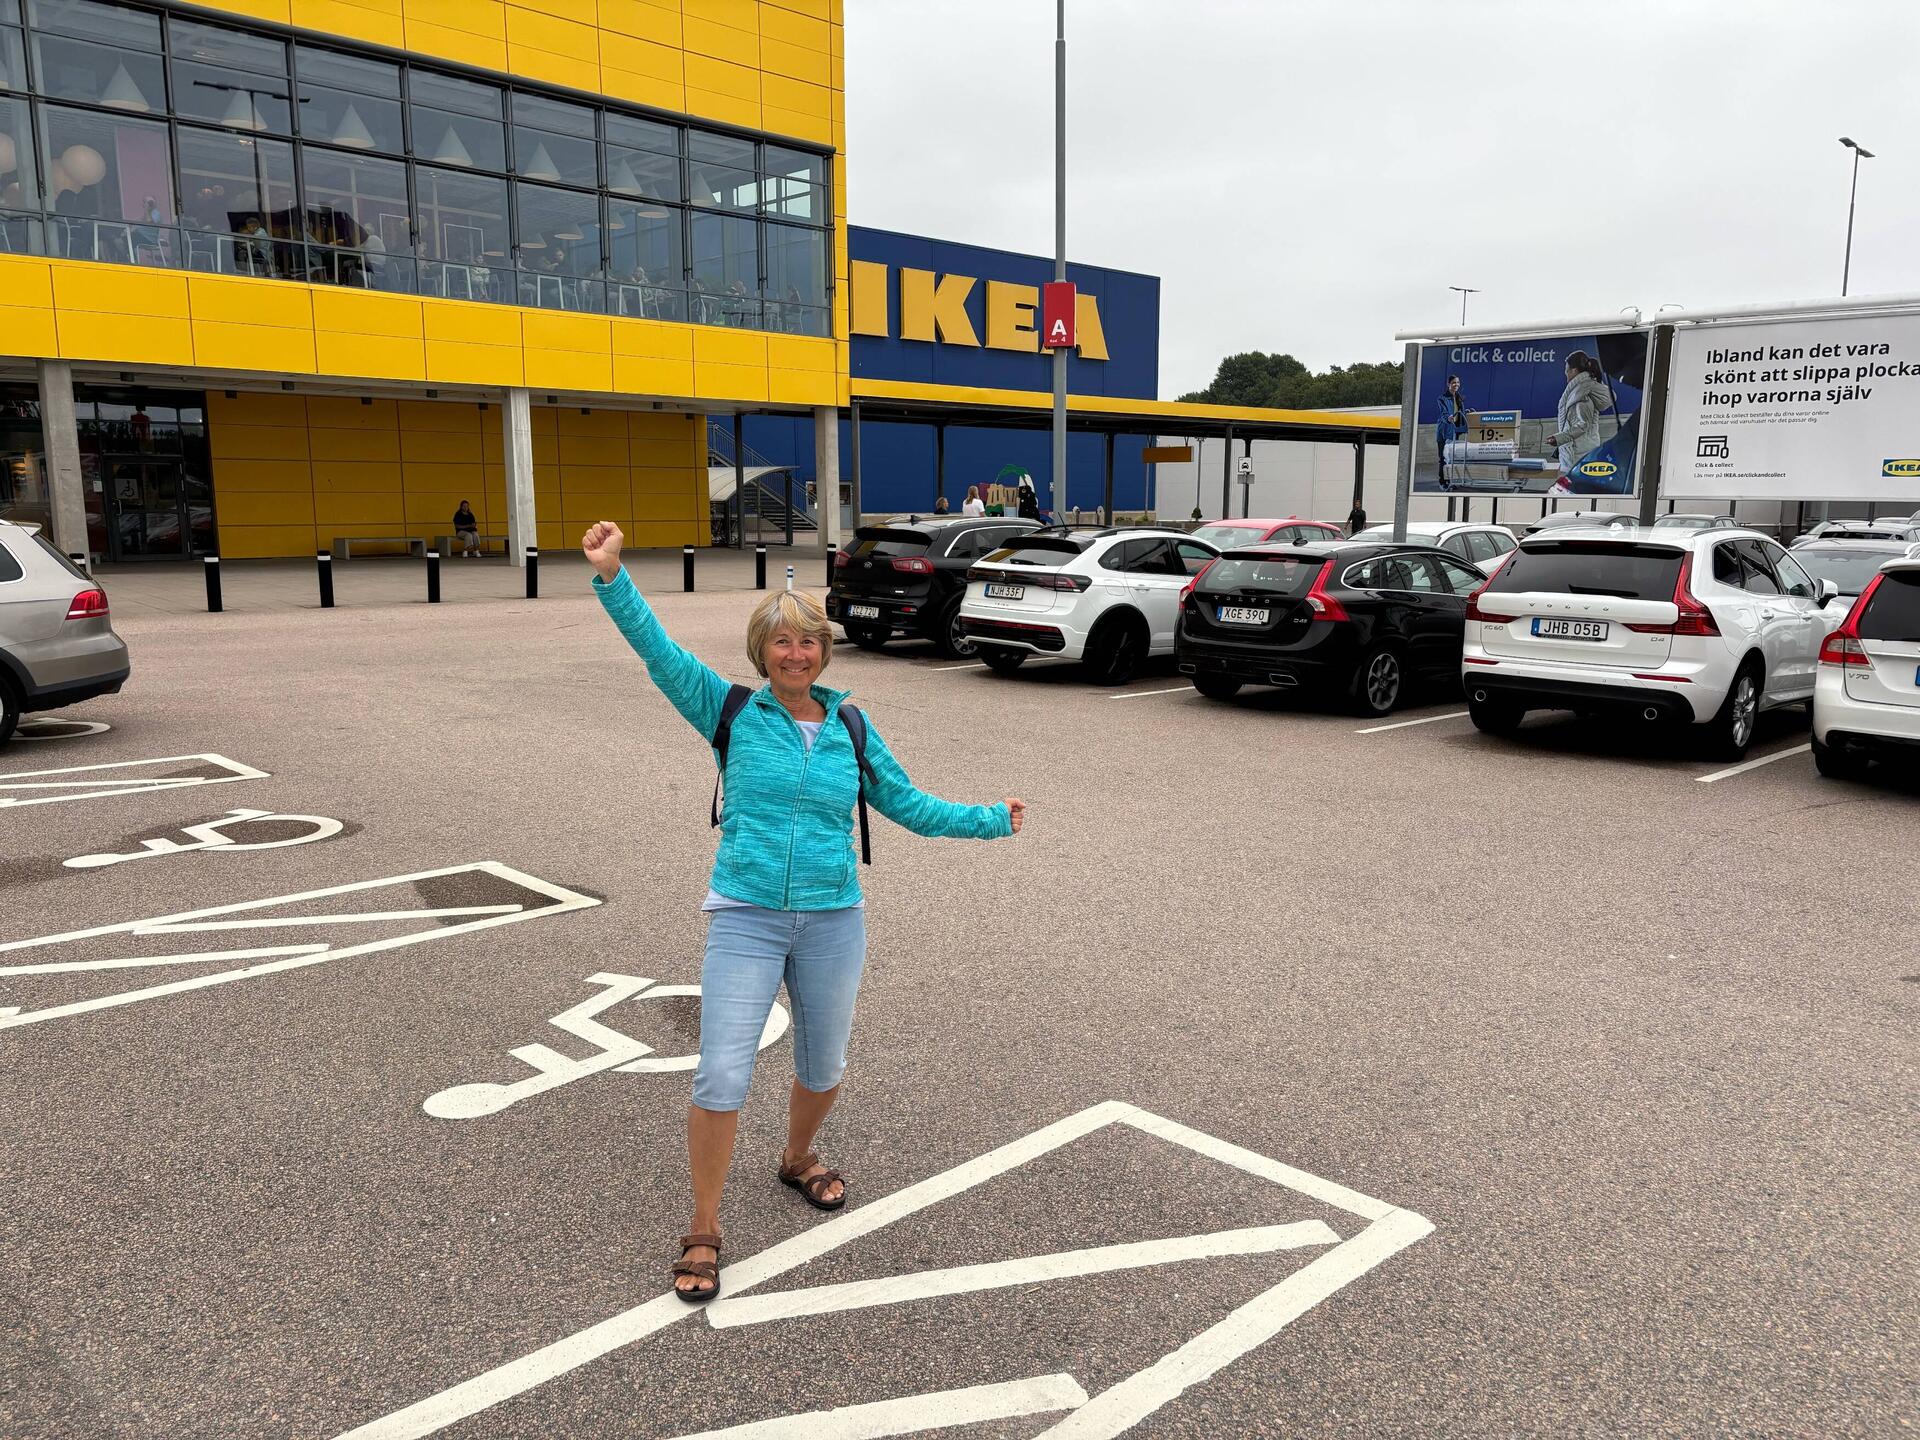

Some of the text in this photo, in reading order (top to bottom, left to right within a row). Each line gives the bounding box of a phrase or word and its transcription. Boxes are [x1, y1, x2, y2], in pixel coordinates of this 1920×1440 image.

[850, 259, 1110, 360] IKEA
[1051, 319, 1067, 336] A
[1451, 347, 1555, 363] Click & collect
[1706, 343, 1890, 364] Ibland kan det vara
[1704, 361, 1920, 385] skönt att slippa plocka
[1702, 385, 1872, 408] ihop varorna själv
[1479, 429, 1504, 441] 19:-
[991, 586, 1020, 597] NJH 33F
[1225, 608, 1264, 620] XGE 390
[1543, 621, 1601, 637] JHB 05B
